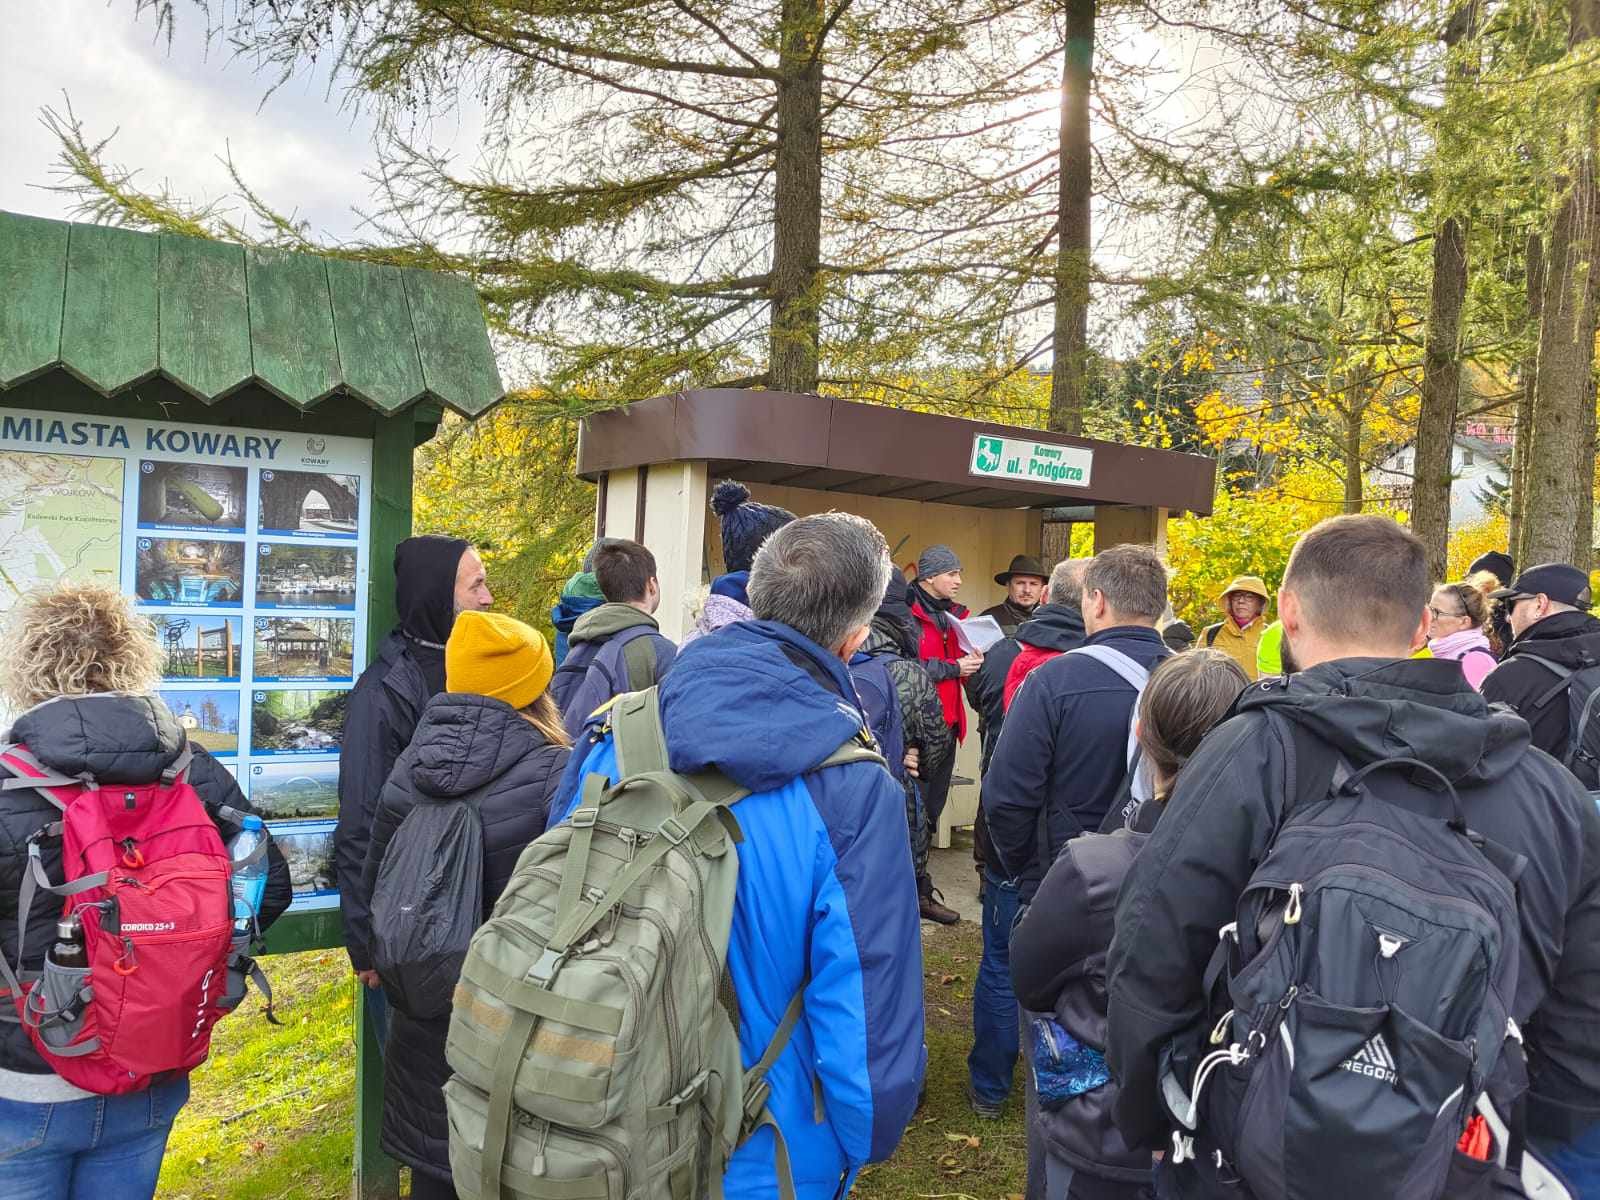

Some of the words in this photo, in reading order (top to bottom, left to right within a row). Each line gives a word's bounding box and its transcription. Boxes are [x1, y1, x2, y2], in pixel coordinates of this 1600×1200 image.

[2, 416, 130, 448] MIASTA
[145, 428, 282, 460] KOWARY
[301, 457, 329, 465] KOWARY
[1034, 445, 1063, 461] Kowary
[1007, 457, 1023, 474] ul.
[1028, 459, 1083, 481] Podgórze
[154, 922, 175, 930] 25+3
